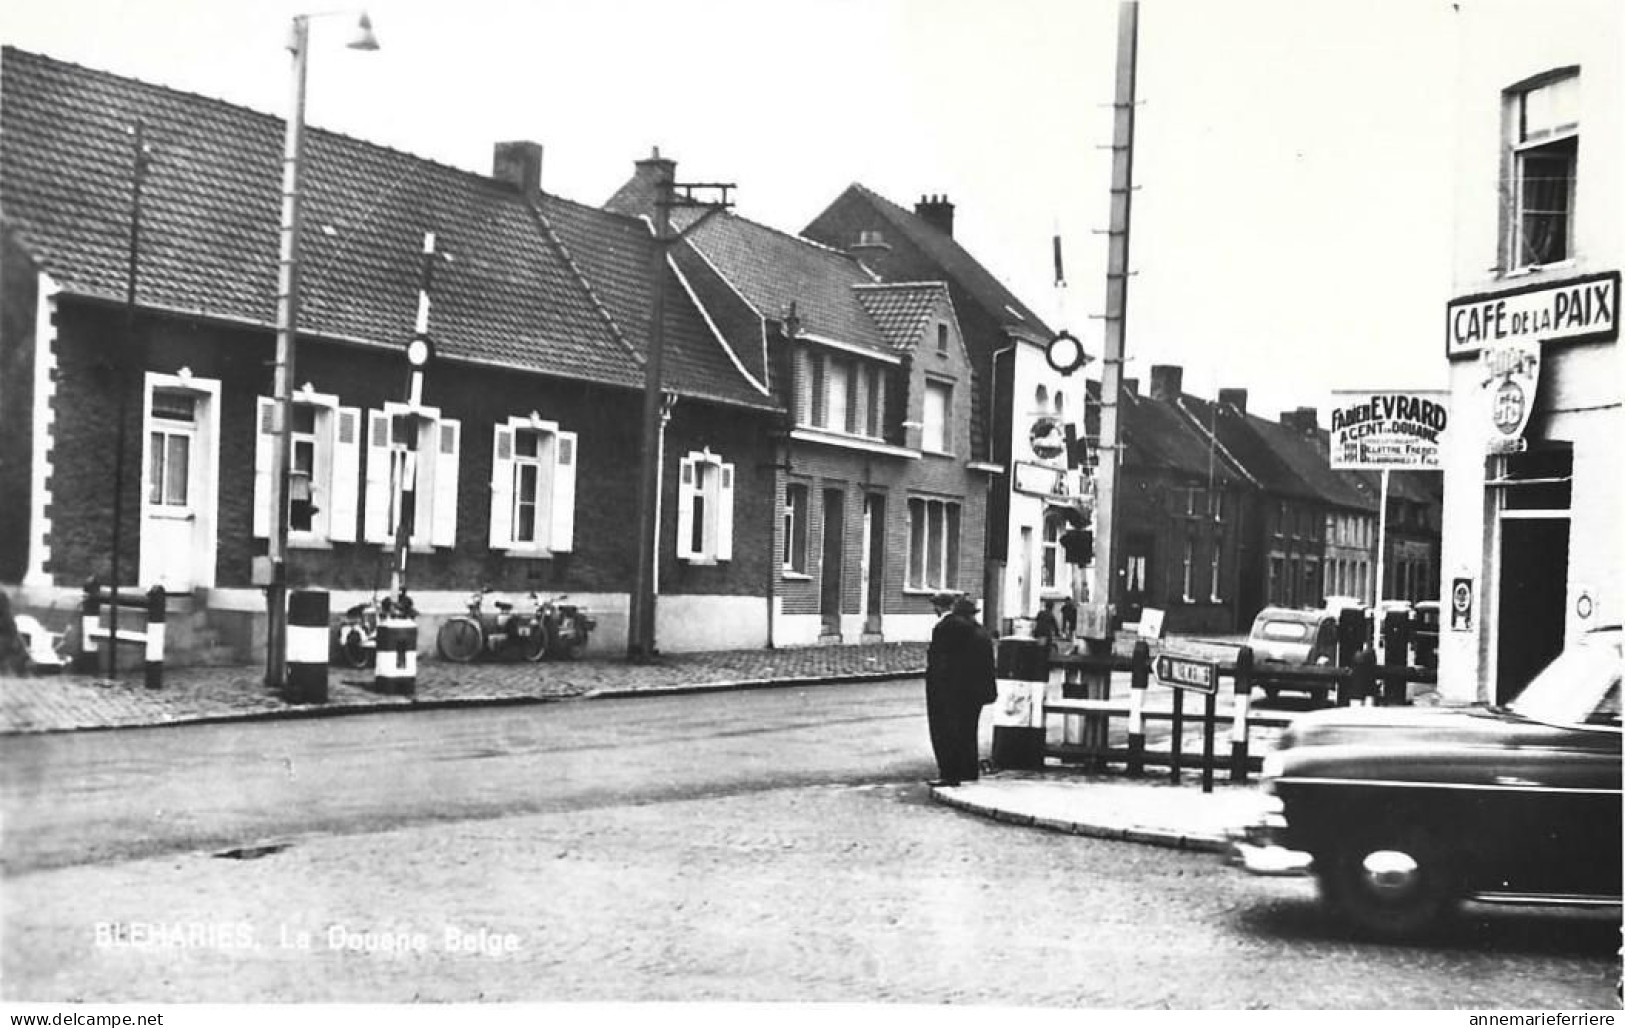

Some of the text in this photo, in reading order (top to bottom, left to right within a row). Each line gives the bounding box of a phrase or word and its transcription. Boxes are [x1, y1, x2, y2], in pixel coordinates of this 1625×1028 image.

[1512, 311, 1528, 335] DE
[1534, 308, 1549, 334] LA
[1554, 284, 1611, 331] PAIX
[1371, 395, 1447, 431] EVRARD
[1340, 421, 1385, 444] AGENT
[1392, 421, 1439, 445] DOUANE
